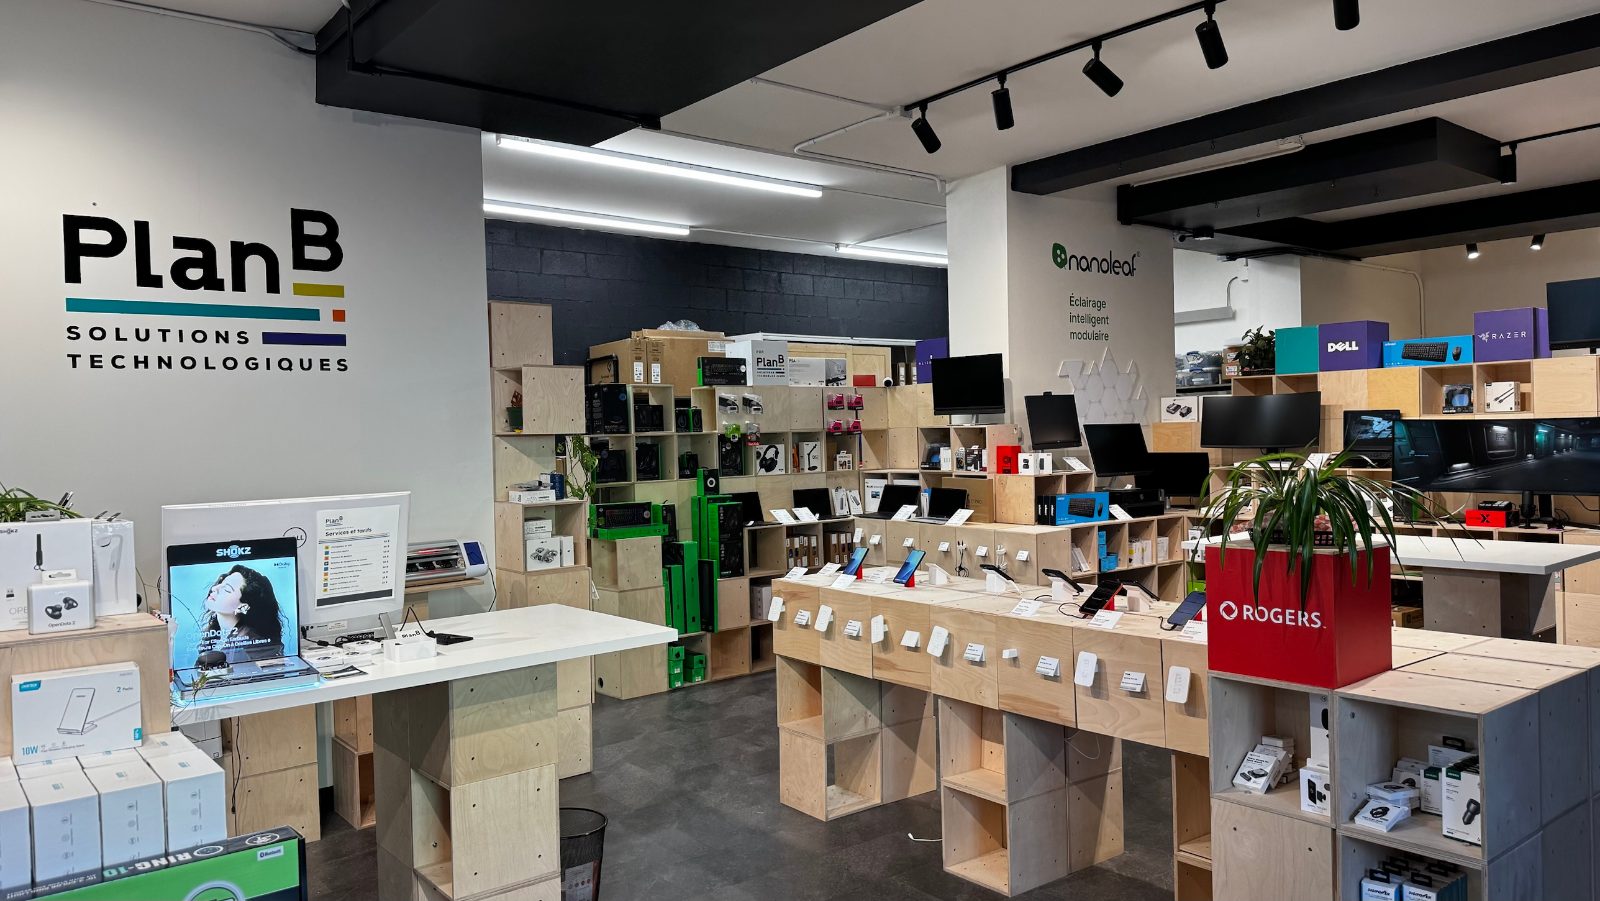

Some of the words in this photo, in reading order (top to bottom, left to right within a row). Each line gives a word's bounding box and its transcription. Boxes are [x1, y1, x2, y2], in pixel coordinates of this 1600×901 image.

[62, 213, 281, 295] Plan
[290, 207, 344, 273] B
[1068, 249, 1137, 277] nanoleaf
[1069, 293, 1107, 312] Éclairage
[1069, 312, 1109, 328] intelligent
[66, 325, 251, 345] SOLUTIONS
[1069, 330, 1110, 341] modulaire
[1491, 331, 1528, 340] RAZER
[1327, 340, 1359, 353] DELL
[66, 353, 349, 372] TECHNOLOGIQUES
[756, 357, 778, 367] Plan
[778, 354, 785, 363] B
[325, 529, 350, 537] Services
[216, 545, 252, 558] SHOKZ
[1242, 604, 1322, 629] ROGERS
[103, 852, 193, 878] RING-10
